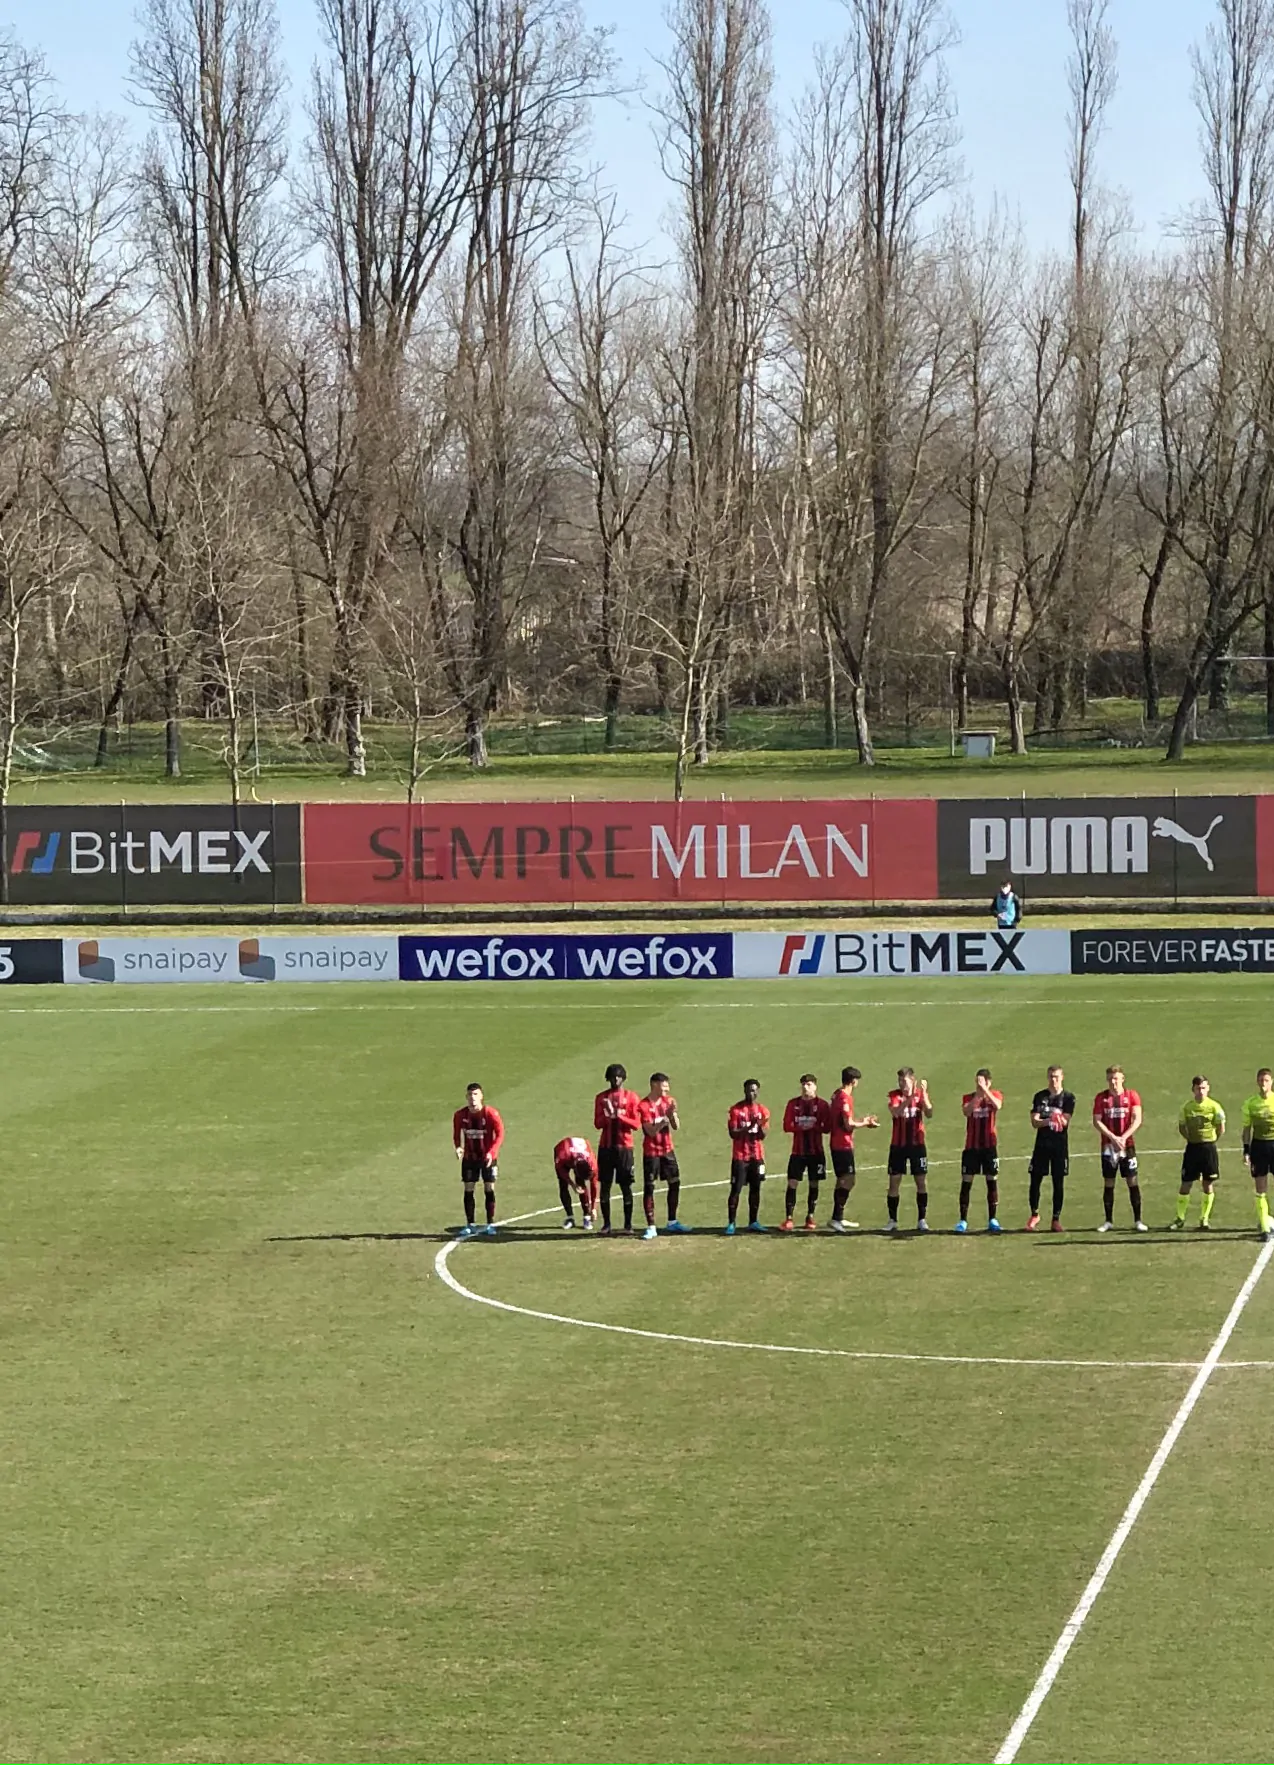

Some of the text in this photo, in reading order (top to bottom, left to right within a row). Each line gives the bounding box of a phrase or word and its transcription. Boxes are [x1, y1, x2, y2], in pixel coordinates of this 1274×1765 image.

[70, 831, 272, 874] BitMEX
[370, 824, 869, 881] SEMPRE MILAN
[969, 816, 1149, 875] PUMA
[124, 948, 228, 973] snaipay
[284, 946, 389, 972] snaipay
[415, 937, 717, 978] wefox wefox
[835, 932, 1026, 974] BitMEX
[1083, 940, 1197, 963] FOREVER
